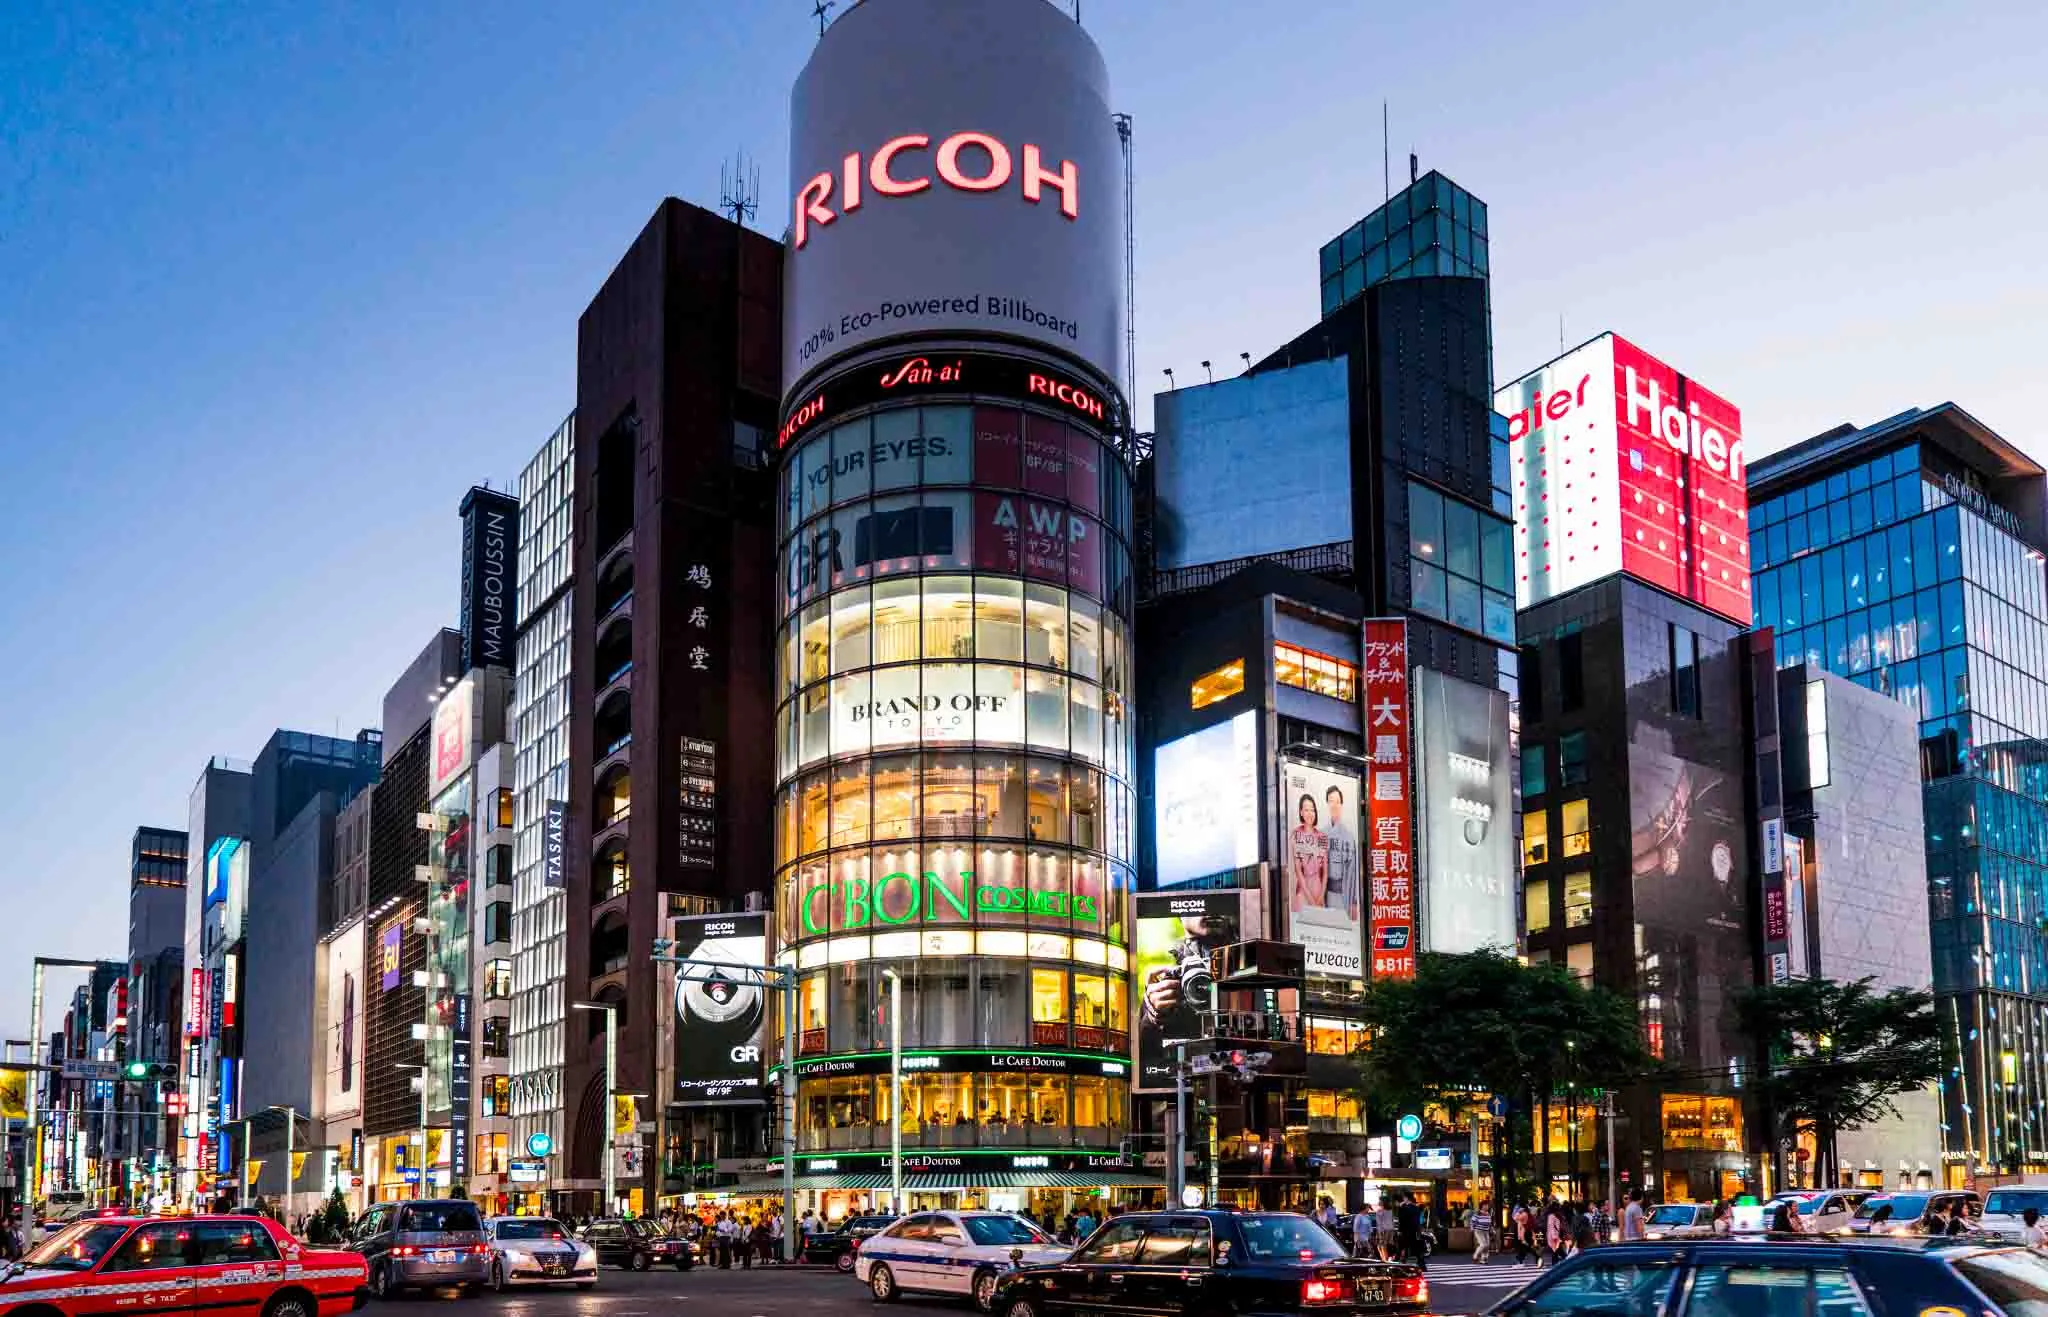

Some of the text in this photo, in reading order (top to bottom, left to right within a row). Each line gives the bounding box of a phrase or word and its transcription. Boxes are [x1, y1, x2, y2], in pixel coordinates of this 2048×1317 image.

[794, 131, 1080, 249] RICOH
[799, 295, 1079, 361] 100% Eco-Powered Billboard
[880, 357, 961, 388] San-ai
[1029, 374, 1105, 420] RICOH
[1509, 373, 1590, 442] aier
[778, 394, 825, 448] RICOH
[1625, 364, 1744, 481] Haier
[807, 450, 865, 491] YOUR
[871, 436, 953, 464] EYES.
[482, 511, 505, 660] MAUBOUSSIN
[684, 564, 712, 671] 鳩居堂
[1366, 641, 1403, 657] ブランド
[1379, 657, 1390, 668] &
[1367, 669, 1404, 684] チケット
[851, 694, 1007, 723] BRAND OFF
[887, 715, 961, 729] TOYO
[548, 809, 562, 879] TASAKI
[1375, 816, 1403, 847] 質
[1371, 849, 1409, 874] 買取
[802, 871, 1097, 935] C'BON COSMETCS
[1371, 876, 1409, 901] 販売
[1170, 900, 1206, 909] RICOH
[1371, 903, 1411, 920] DUTYFREE
[704, 922, 735, 931] RICOH
[384, 943, 399, 974] GU
[1306, 951, 1360, 969] rweave
[1386, 958, 1412, 972] B1F
[730, 1046, 760, 1063] GR
[1033, 1056, 1066, 1067] DOUTOR
[509, 1072, 559, 1102] TASAKI
[923, 1155, 961, 1166] DOUTOR
